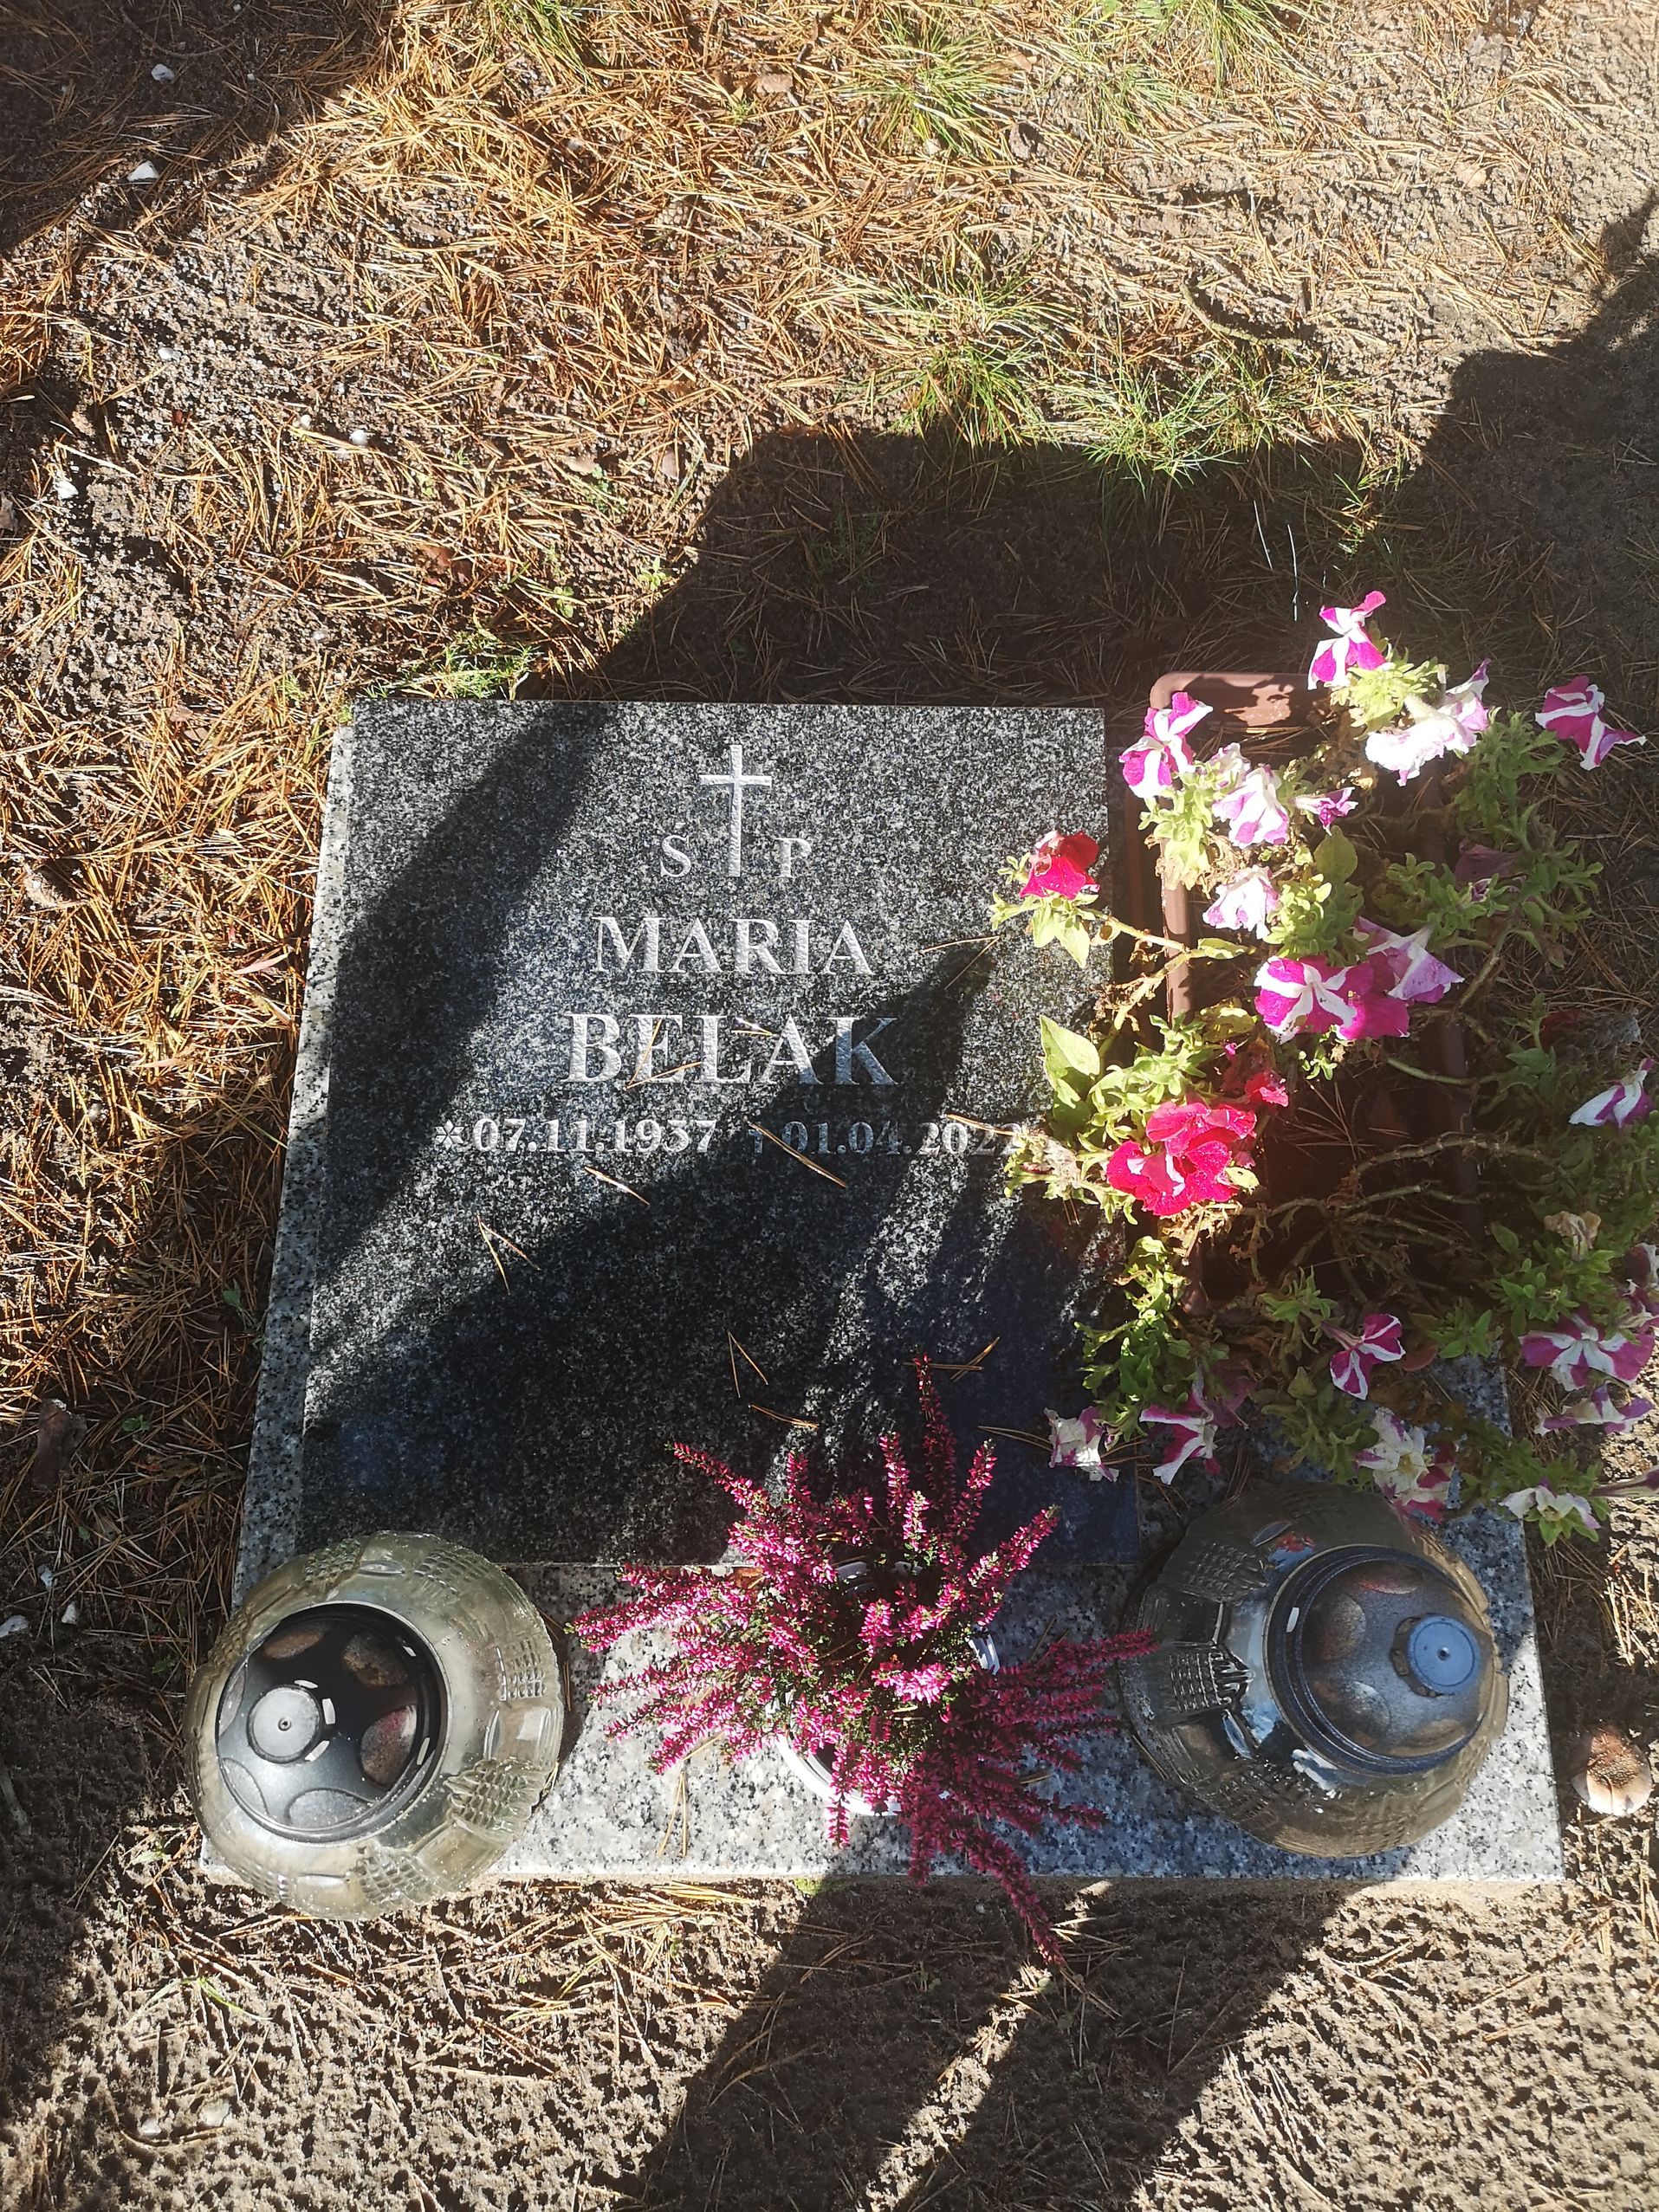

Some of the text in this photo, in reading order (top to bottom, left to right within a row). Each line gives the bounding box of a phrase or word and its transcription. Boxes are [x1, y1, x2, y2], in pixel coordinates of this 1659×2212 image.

[774, 837, 813, 879] P
[591, 915, 875, 976] MARIA
[560, 1012, 899, 1086] BELAK
[475, 1117, 718, 1155] 07.11.1937
